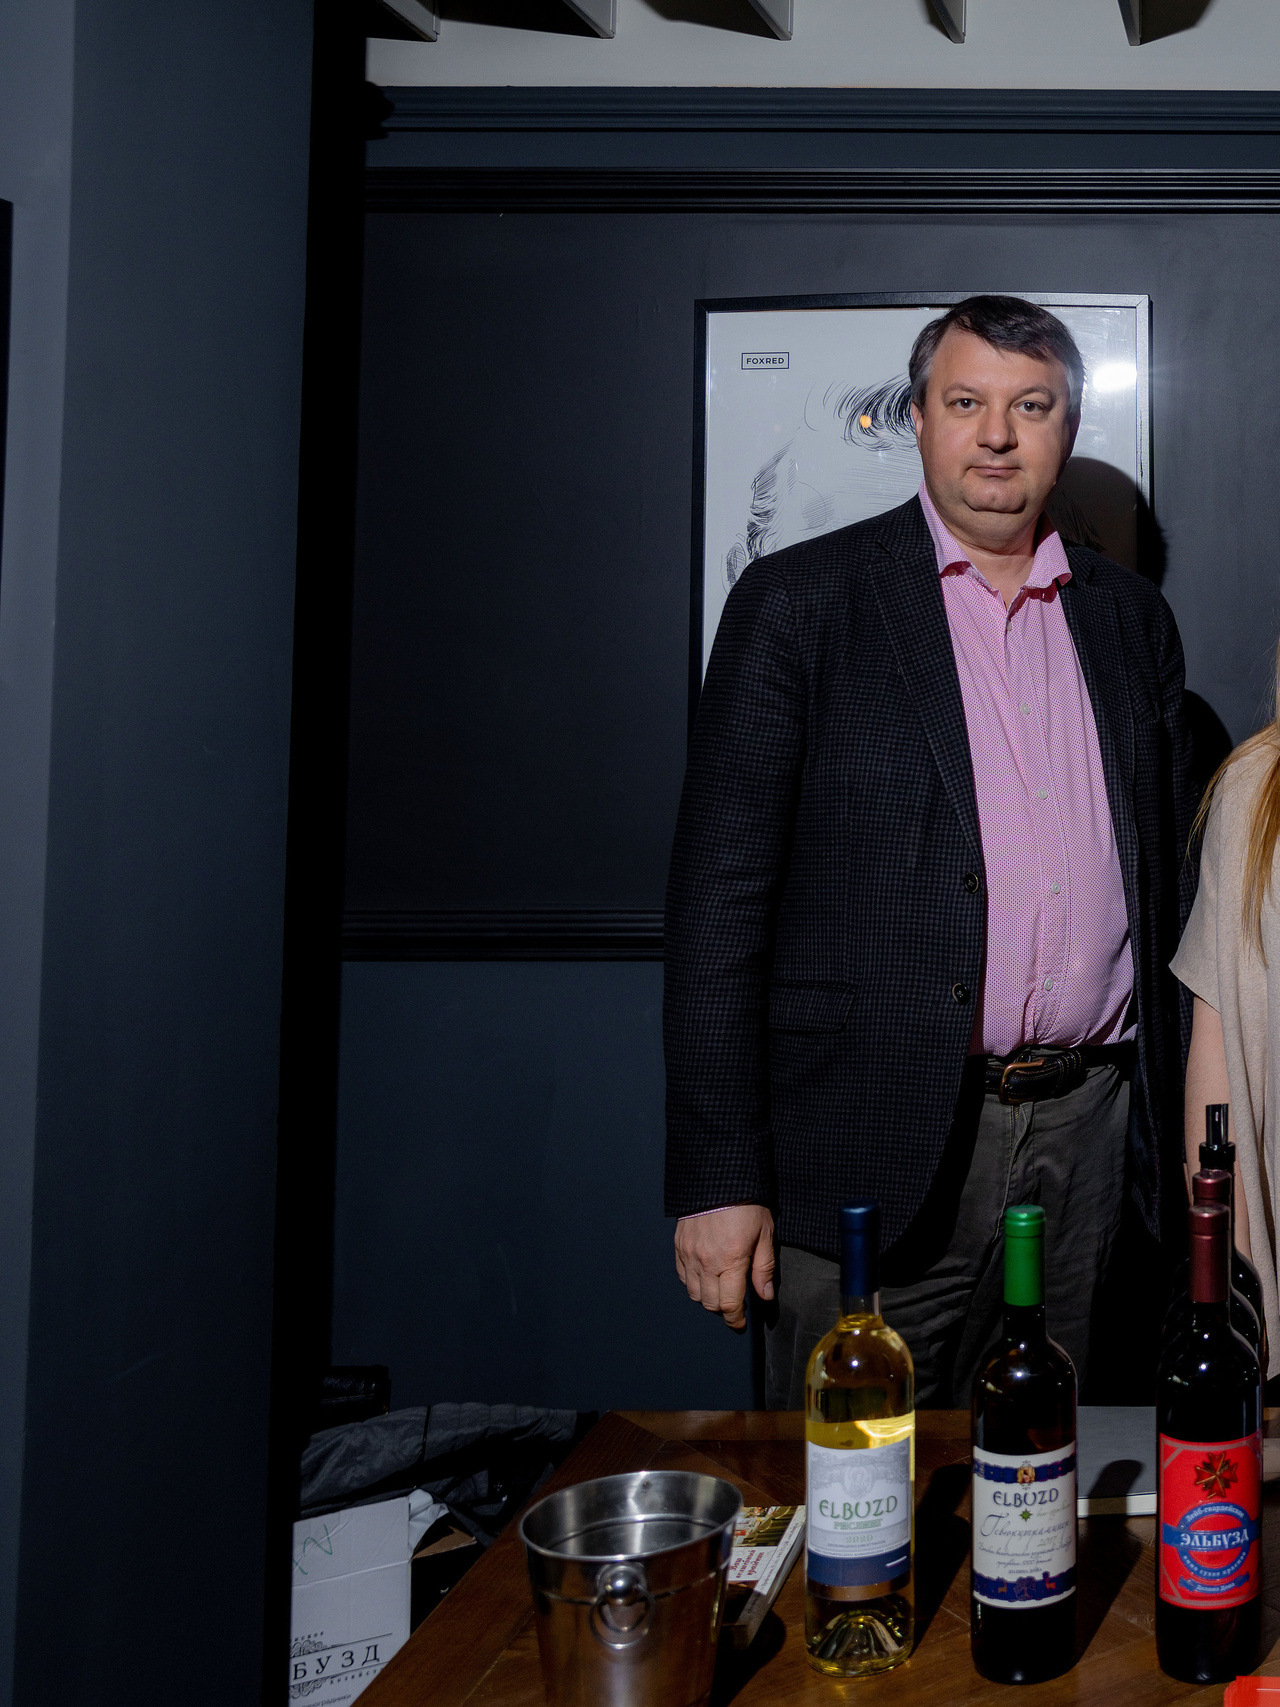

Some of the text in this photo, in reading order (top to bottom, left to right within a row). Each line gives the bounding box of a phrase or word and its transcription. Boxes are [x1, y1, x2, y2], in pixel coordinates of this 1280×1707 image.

[746, 357, 785, 365] FOXRED
[818, 1495, 899, 1521] ELBUZD
[992, 1488, 1059, 1508] ELBUZD
[1180, 1528, 1250, 1549] ЭЛЬБУЗД
